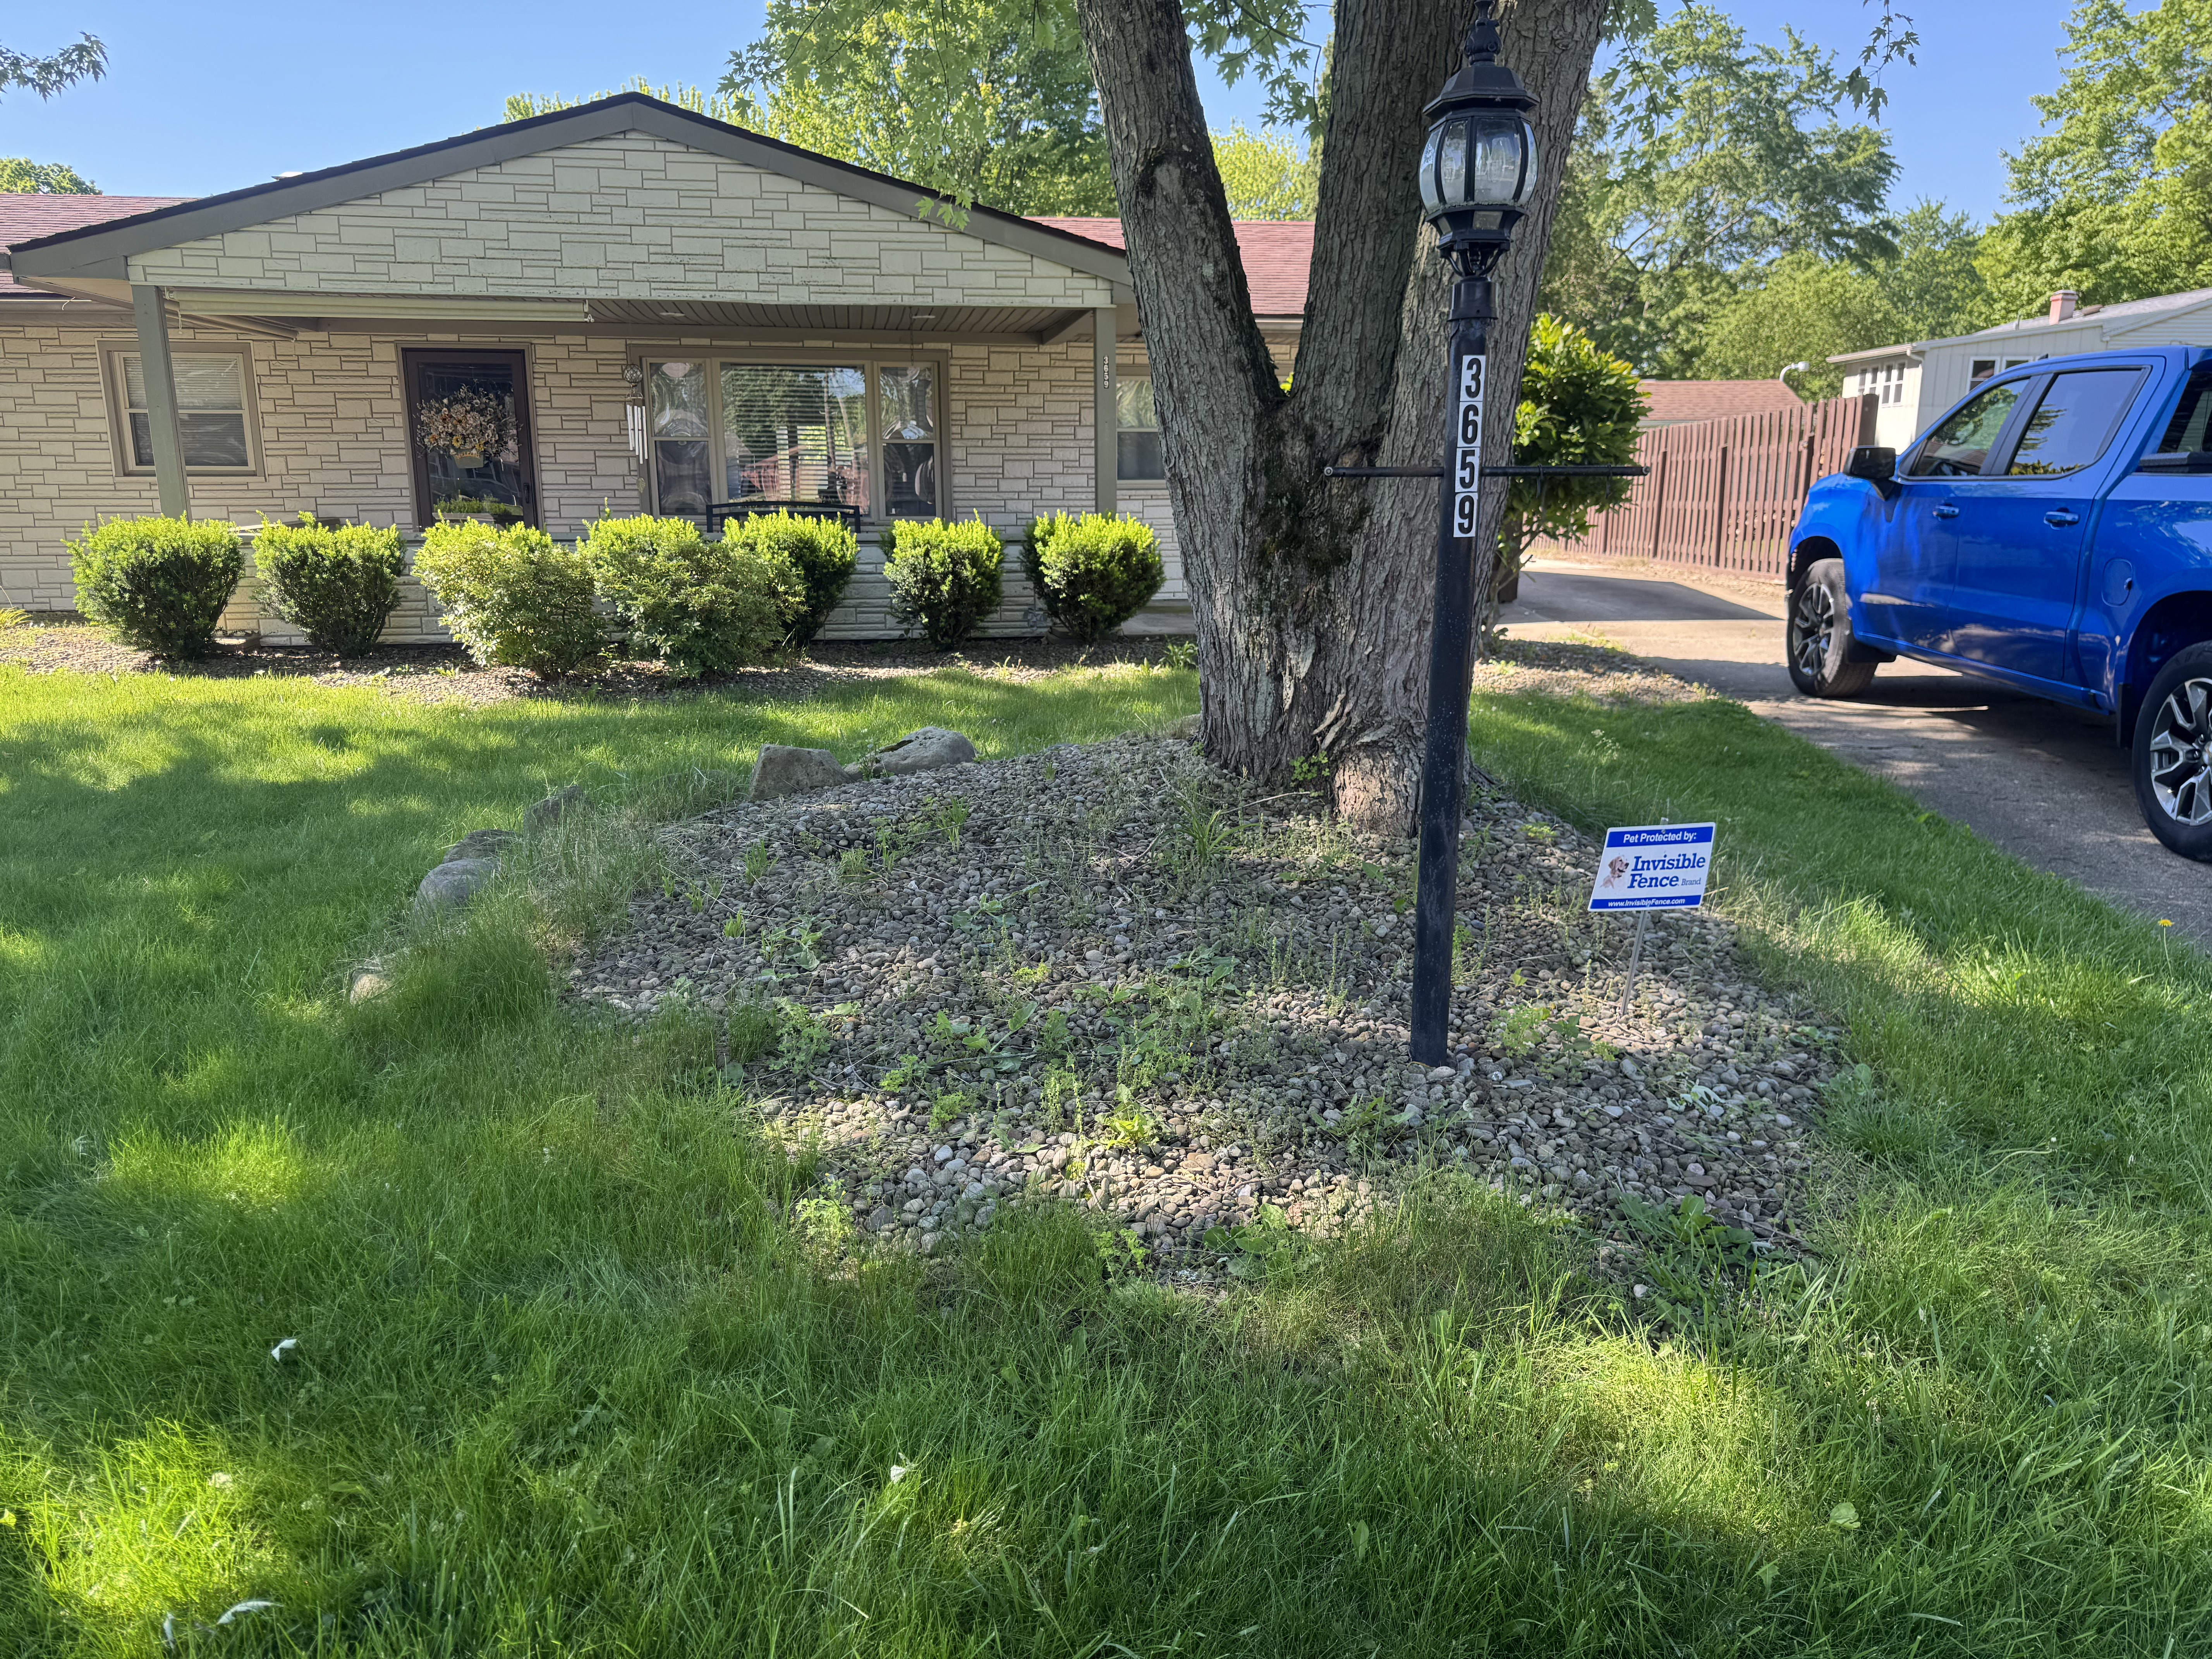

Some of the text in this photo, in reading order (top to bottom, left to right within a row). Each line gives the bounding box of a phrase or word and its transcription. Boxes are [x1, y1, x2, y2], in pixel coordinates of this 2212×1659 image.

[1457, 357, 1482, 534] 3659
[1623, 831, 1697, 843] Pet Protected by:
[1631, 853, 1705, 872] Invisible
[1627, 873, 1701, 889] Fence Brand
[1608, 898, 1685, 907] www.InvisibleFence.com
